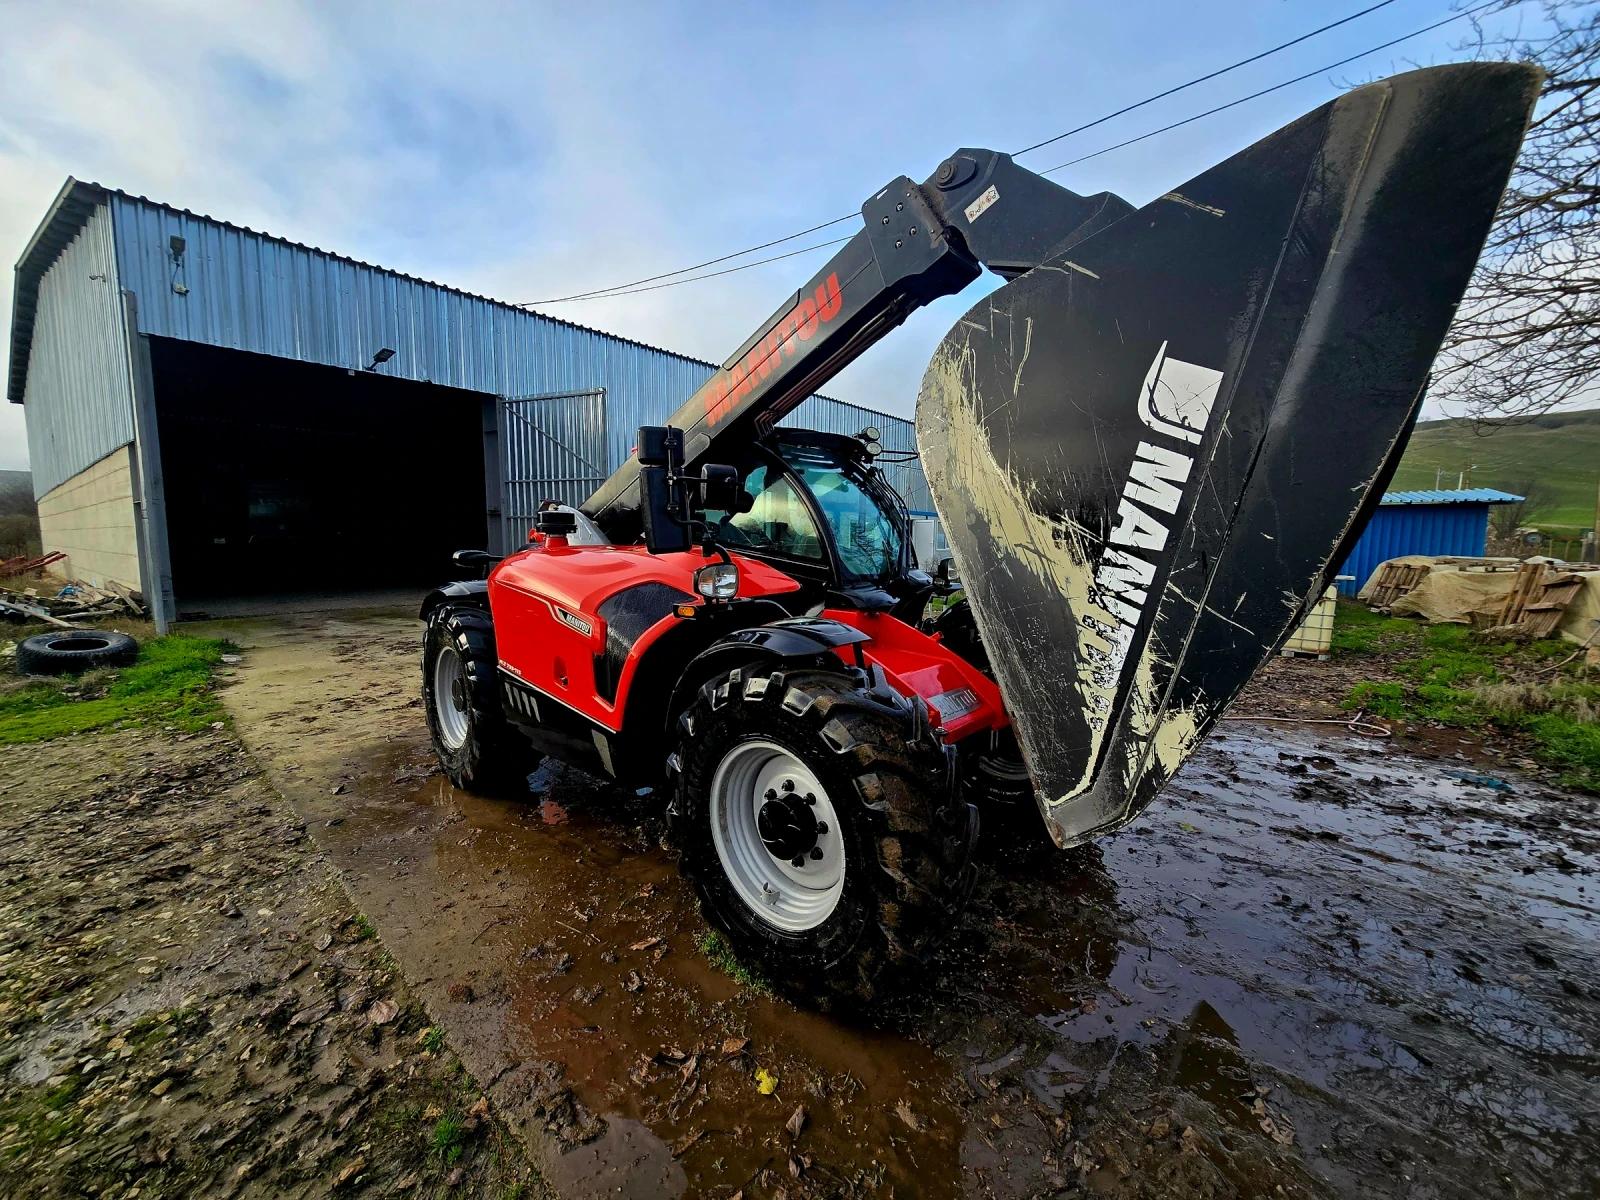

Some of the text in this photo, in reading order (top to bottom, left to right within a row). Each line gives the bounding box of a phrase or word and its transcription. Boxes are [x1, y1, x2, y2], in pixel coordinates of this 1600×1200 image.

[704, 271, 842, 427] MANITOU
[566, 613, 590, 633] MANITOU
[936, 689, 977, 718] ANITOU
